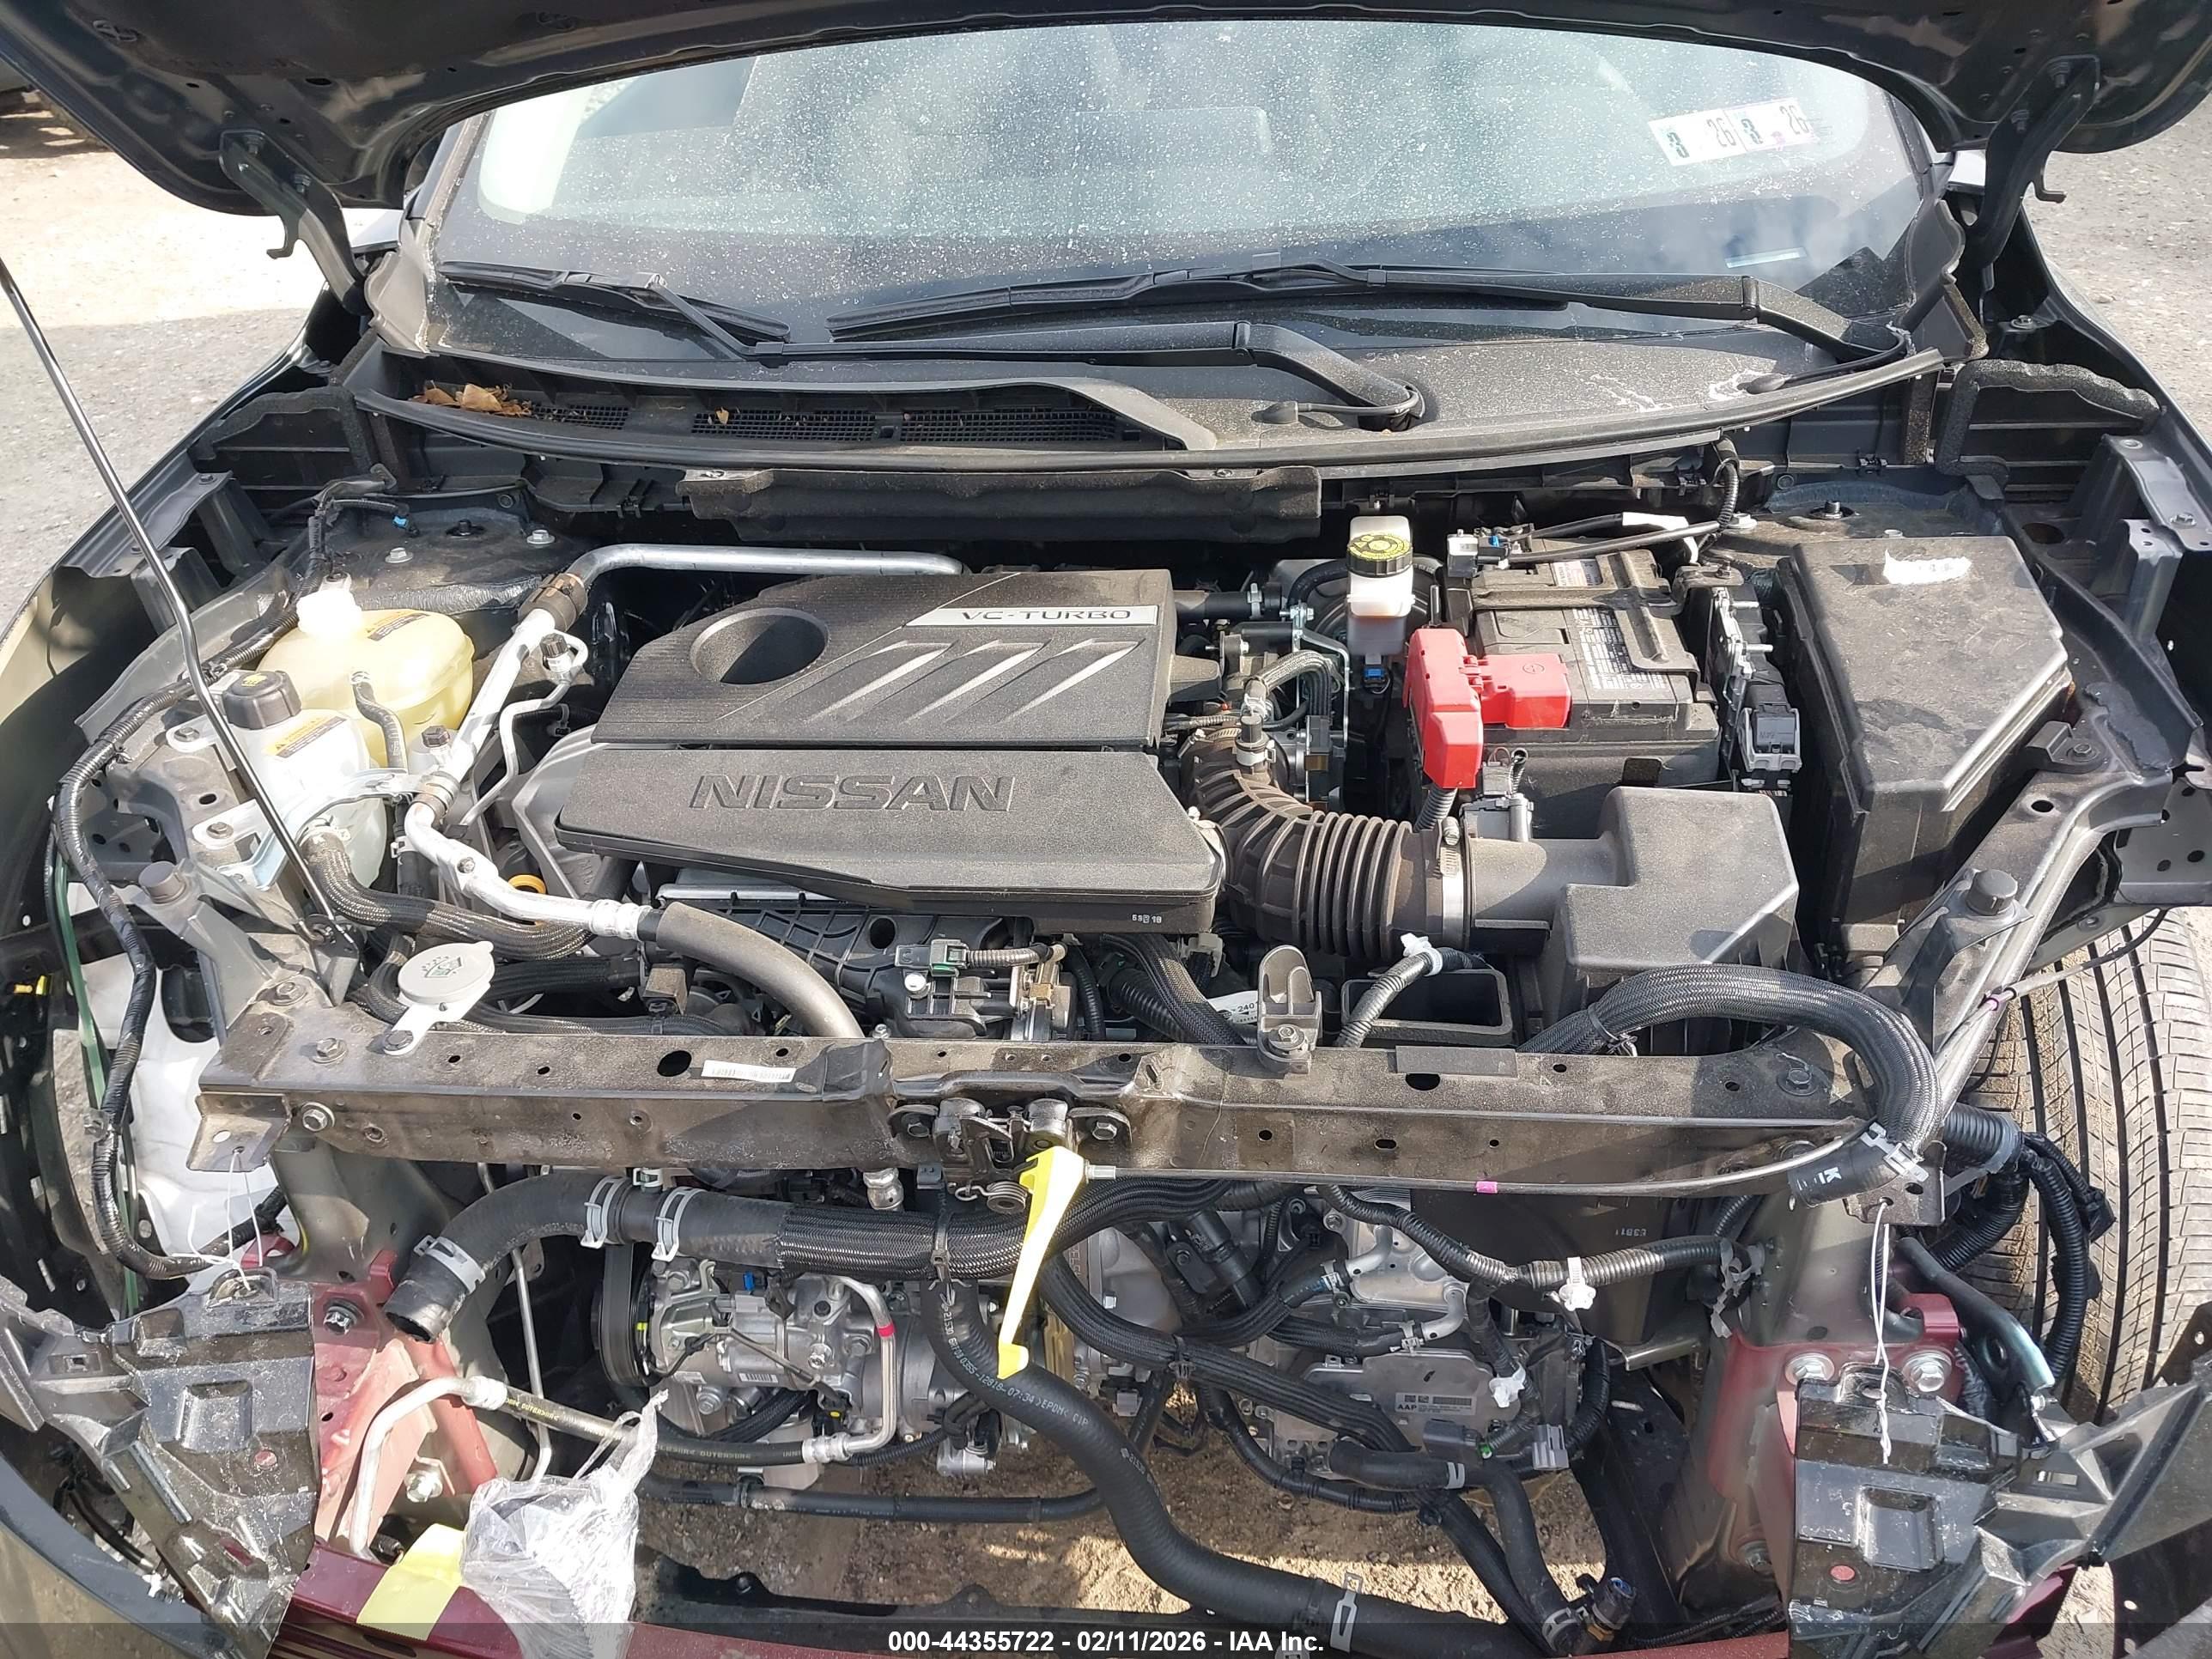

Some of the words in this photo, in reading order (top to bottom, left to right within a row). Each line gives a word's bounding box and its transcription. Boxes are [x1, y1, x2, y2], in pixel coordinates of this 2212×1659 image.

[1706, 118, 1736, 147] 26
[1779, 105, 1809, 135] 26
[962, 611, 1131, 620] VC-TURBO
[689, 775, 1016, 811] NISSAN
